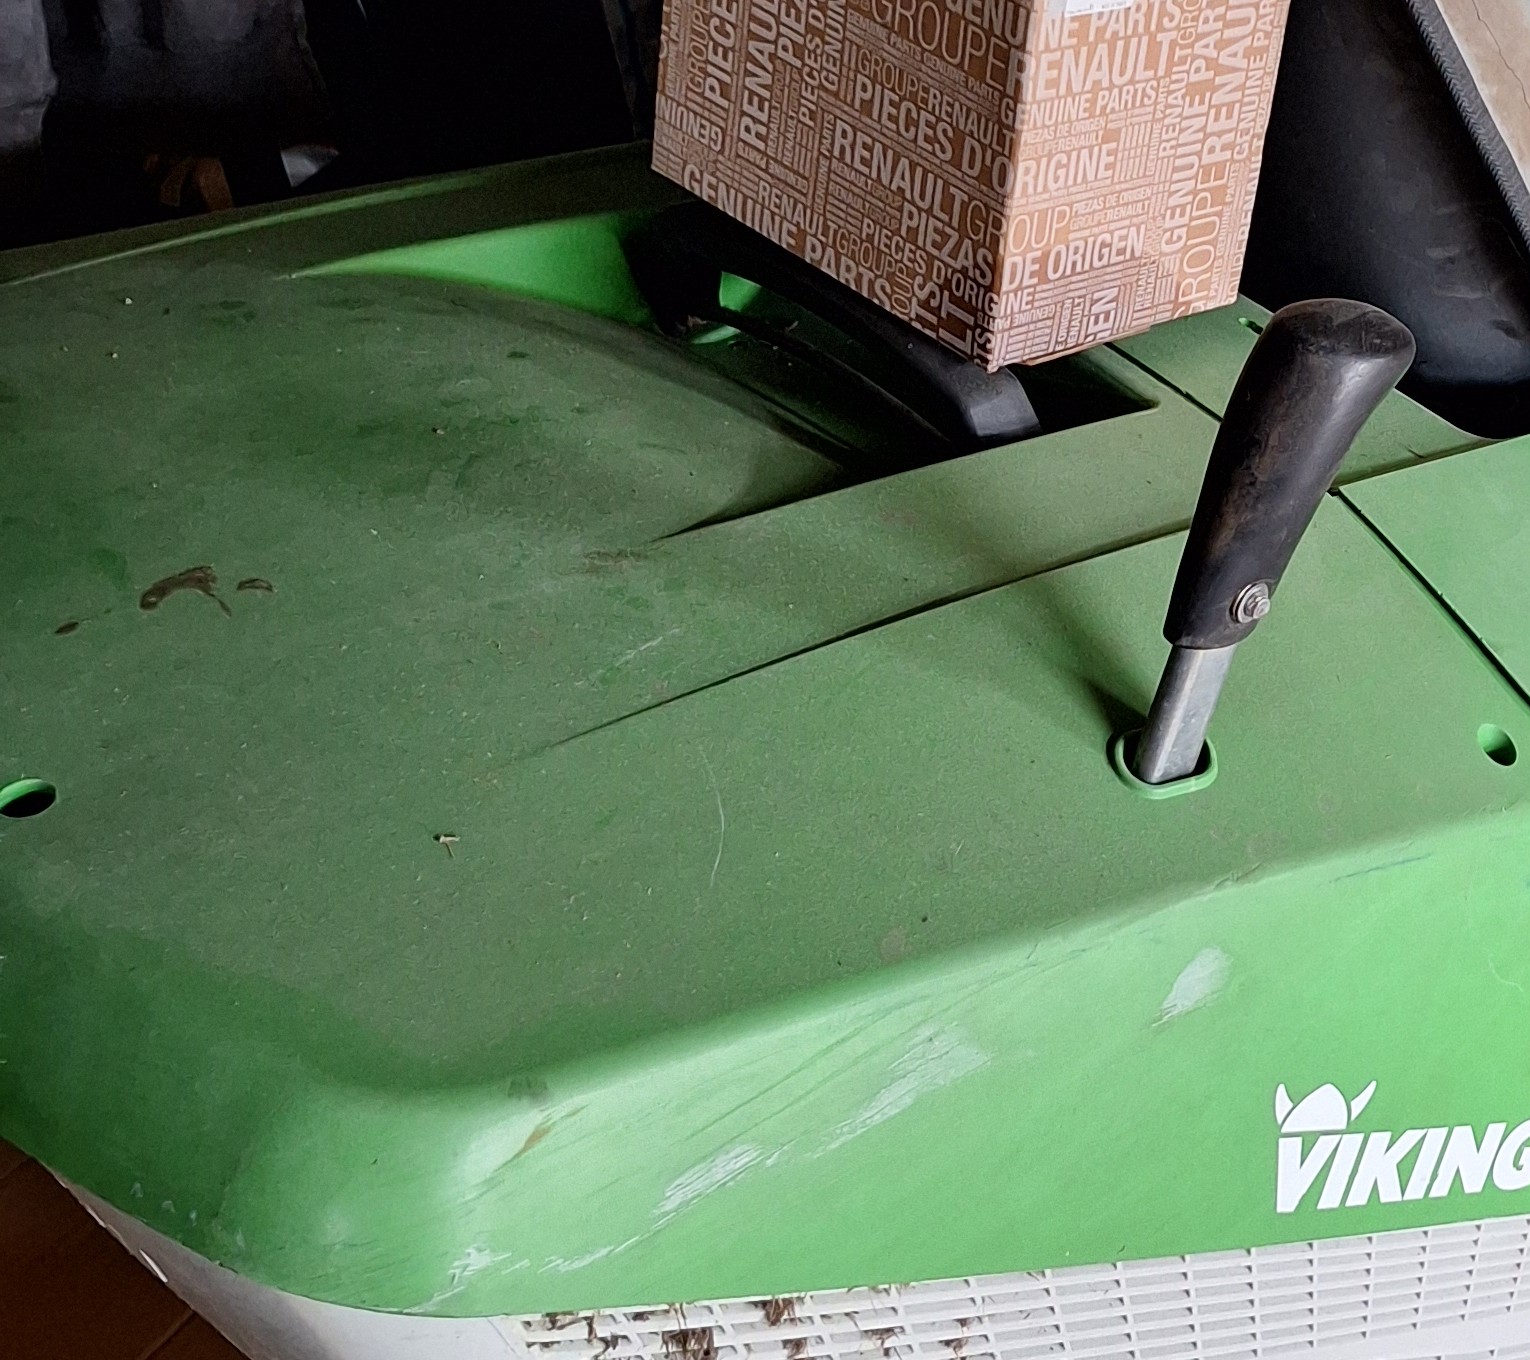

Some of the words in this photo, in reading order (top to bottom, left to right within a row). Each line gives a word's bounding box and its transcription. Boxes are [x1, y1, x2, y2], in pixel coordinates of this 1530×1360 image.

[799, 30, 823, 128] PIECES
[853, 72, 955, 164] PIECES
[858, 46, 1015, 159] GROUPERENAULT
[1094, 79, 1158, 116] PARTS
[1232, 52, 1267, 161] GENUINE
[1159, 90, 1211, 255] GENUINE
[683, 160, 798, 255] GENUINE
[803, 232, 893, 311] PARTS
[757, 178, 896, 283] RENAULTGROUP
[861, 216, 928, 277] PIECES
[899, 200, 995, 290] PIEZAS
[1002, 249, 1042, 293] DE
[1045, 223, 1146, 282] ORIGEN
